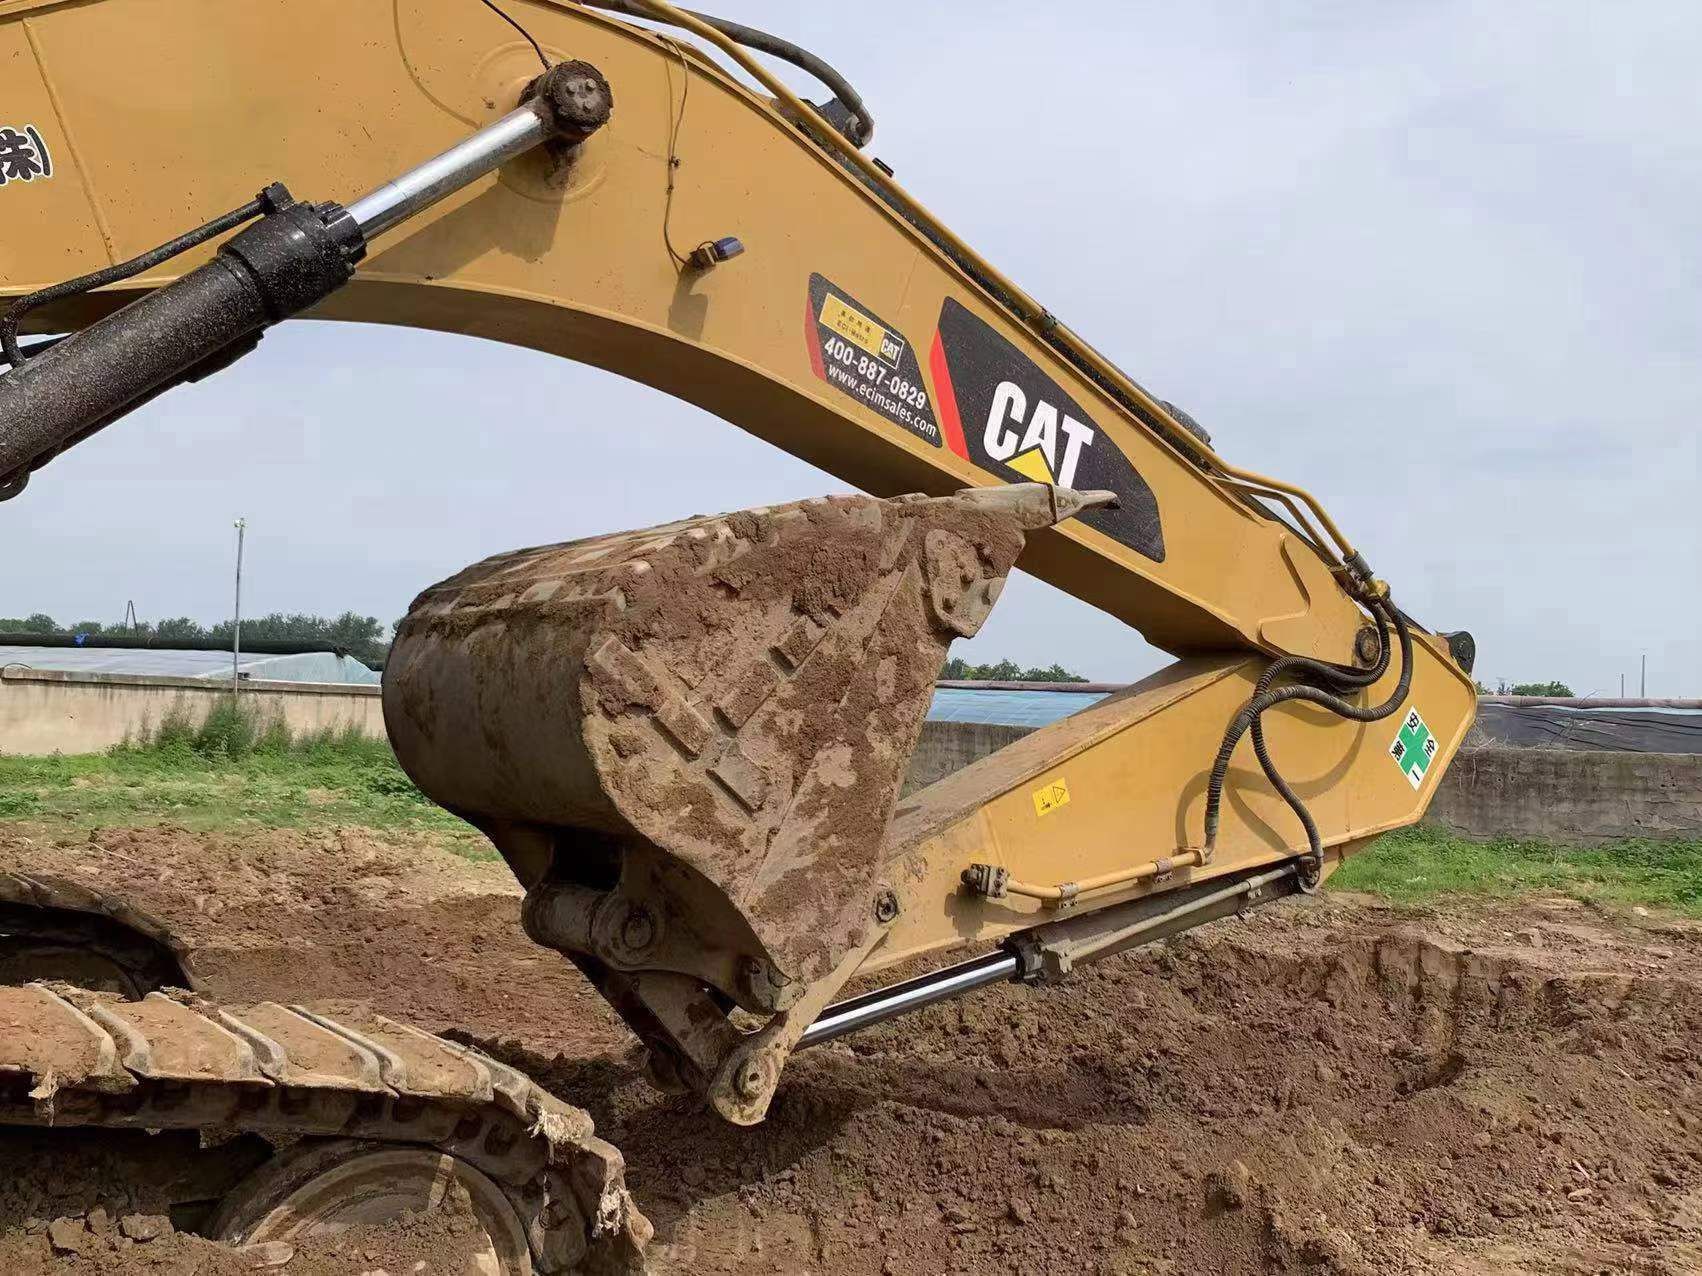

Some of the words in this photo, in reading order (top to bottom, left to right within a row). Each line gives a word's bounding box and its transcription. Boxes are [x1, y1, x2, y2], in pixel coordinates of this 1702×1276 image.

[824, 338, 927, 410] 400-887-0829
[881, 338, 900, 361] CAT
[828, 364, 937, 437] www.ecimsales.com
[983, 380, 1095, 490] CAT
